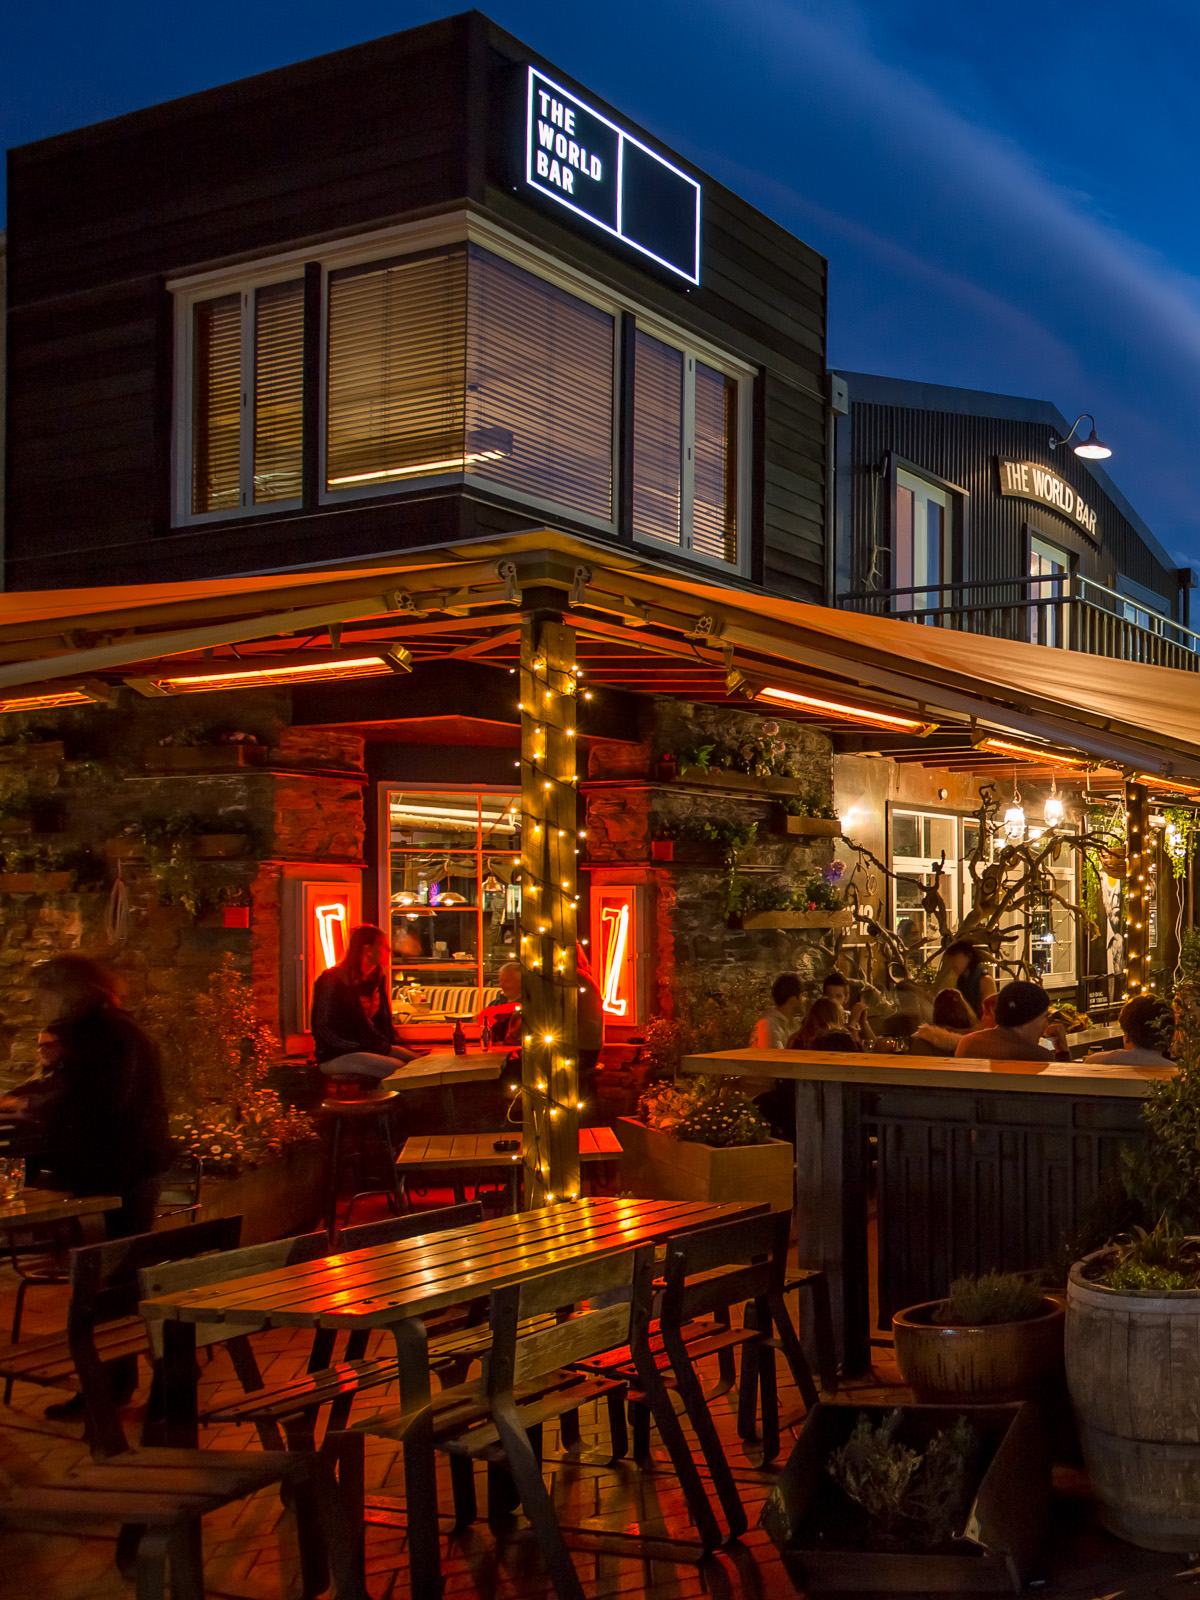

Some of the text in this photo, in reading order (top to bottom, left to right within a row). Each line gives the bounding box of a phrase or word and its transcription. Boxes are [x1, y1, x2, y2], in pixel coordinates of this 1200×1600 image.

[538, 89, 576, 136] THE
[536, 150, 575, 195] BAR
[537, 119, 603, 182] WORLD
[1004, 461, 1097, 535] THE WORLD BAR
